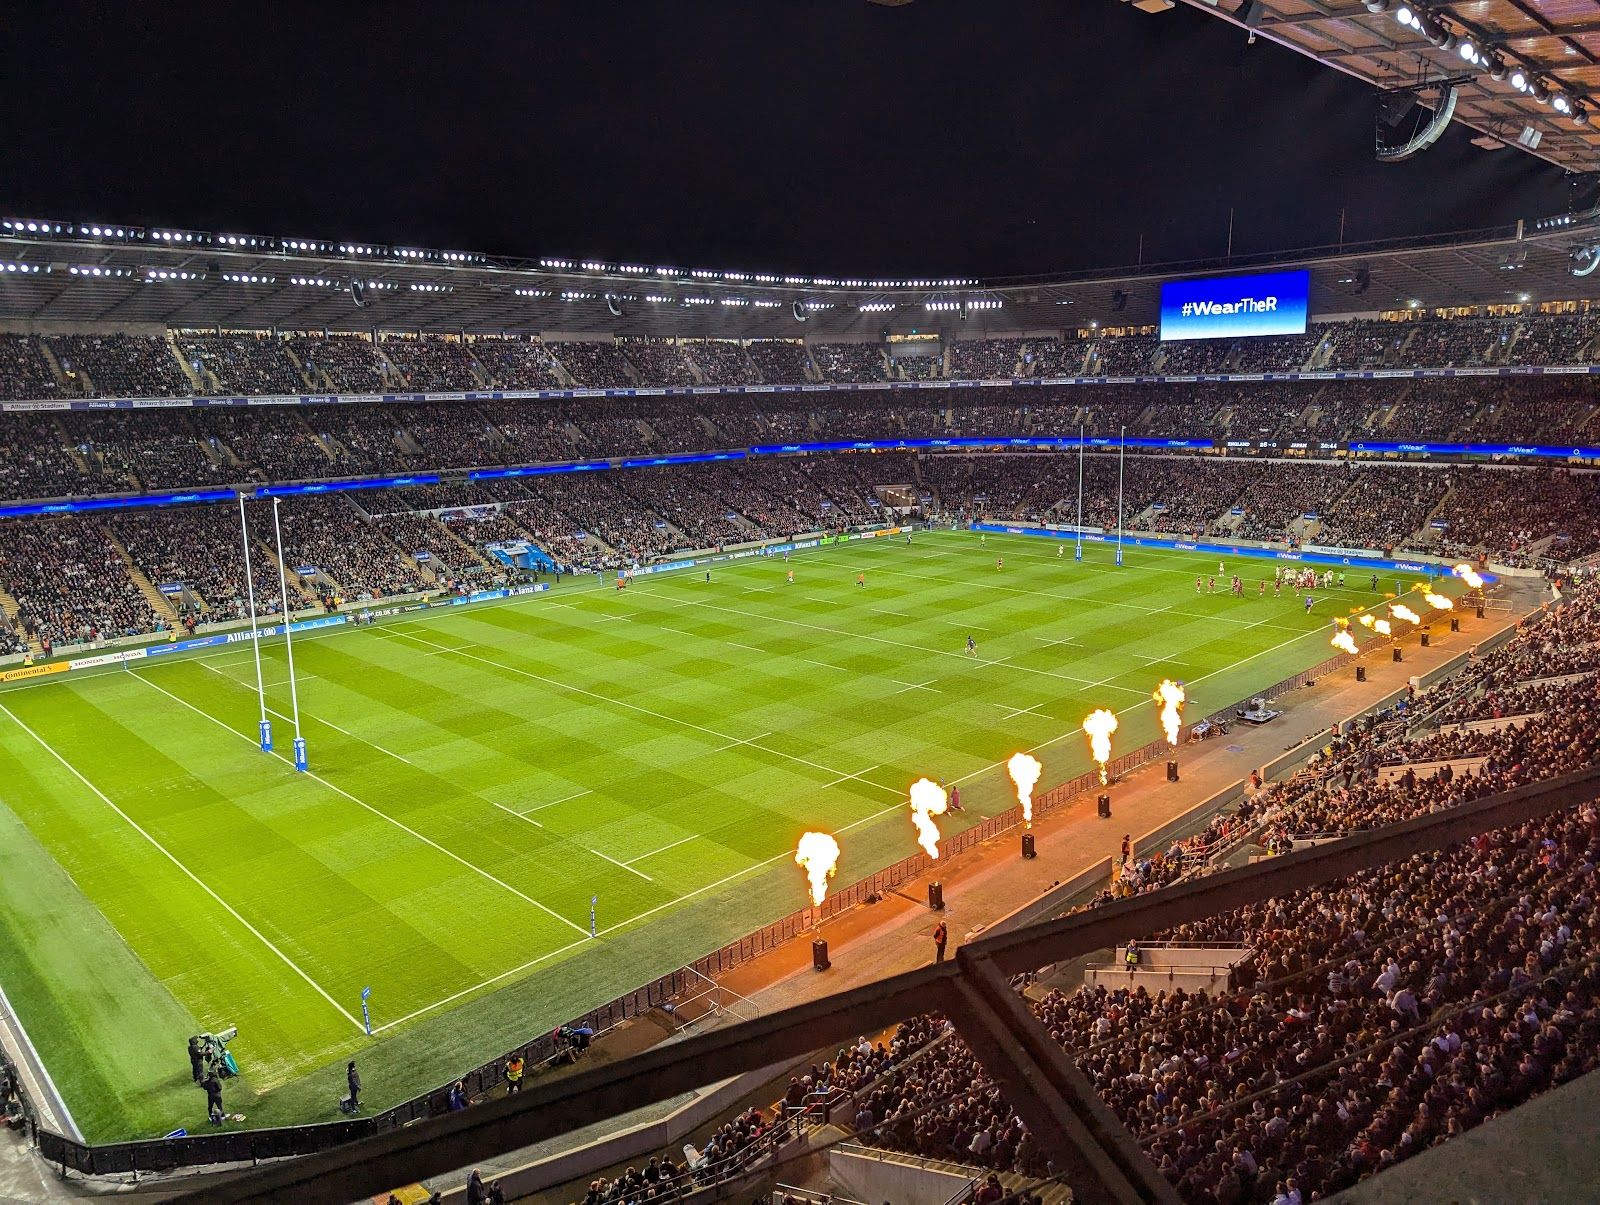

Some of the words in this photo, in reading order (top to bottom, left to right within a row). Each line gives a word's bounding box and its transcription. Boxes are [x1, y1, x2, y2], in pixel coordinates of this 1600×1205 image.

[1181, 297, 1277, 317] #WearTheR
[227, 630, 262, 643] Allianz
[74, 658, 104, 667] HONDA
[5, 666, 46, 680] Continental
